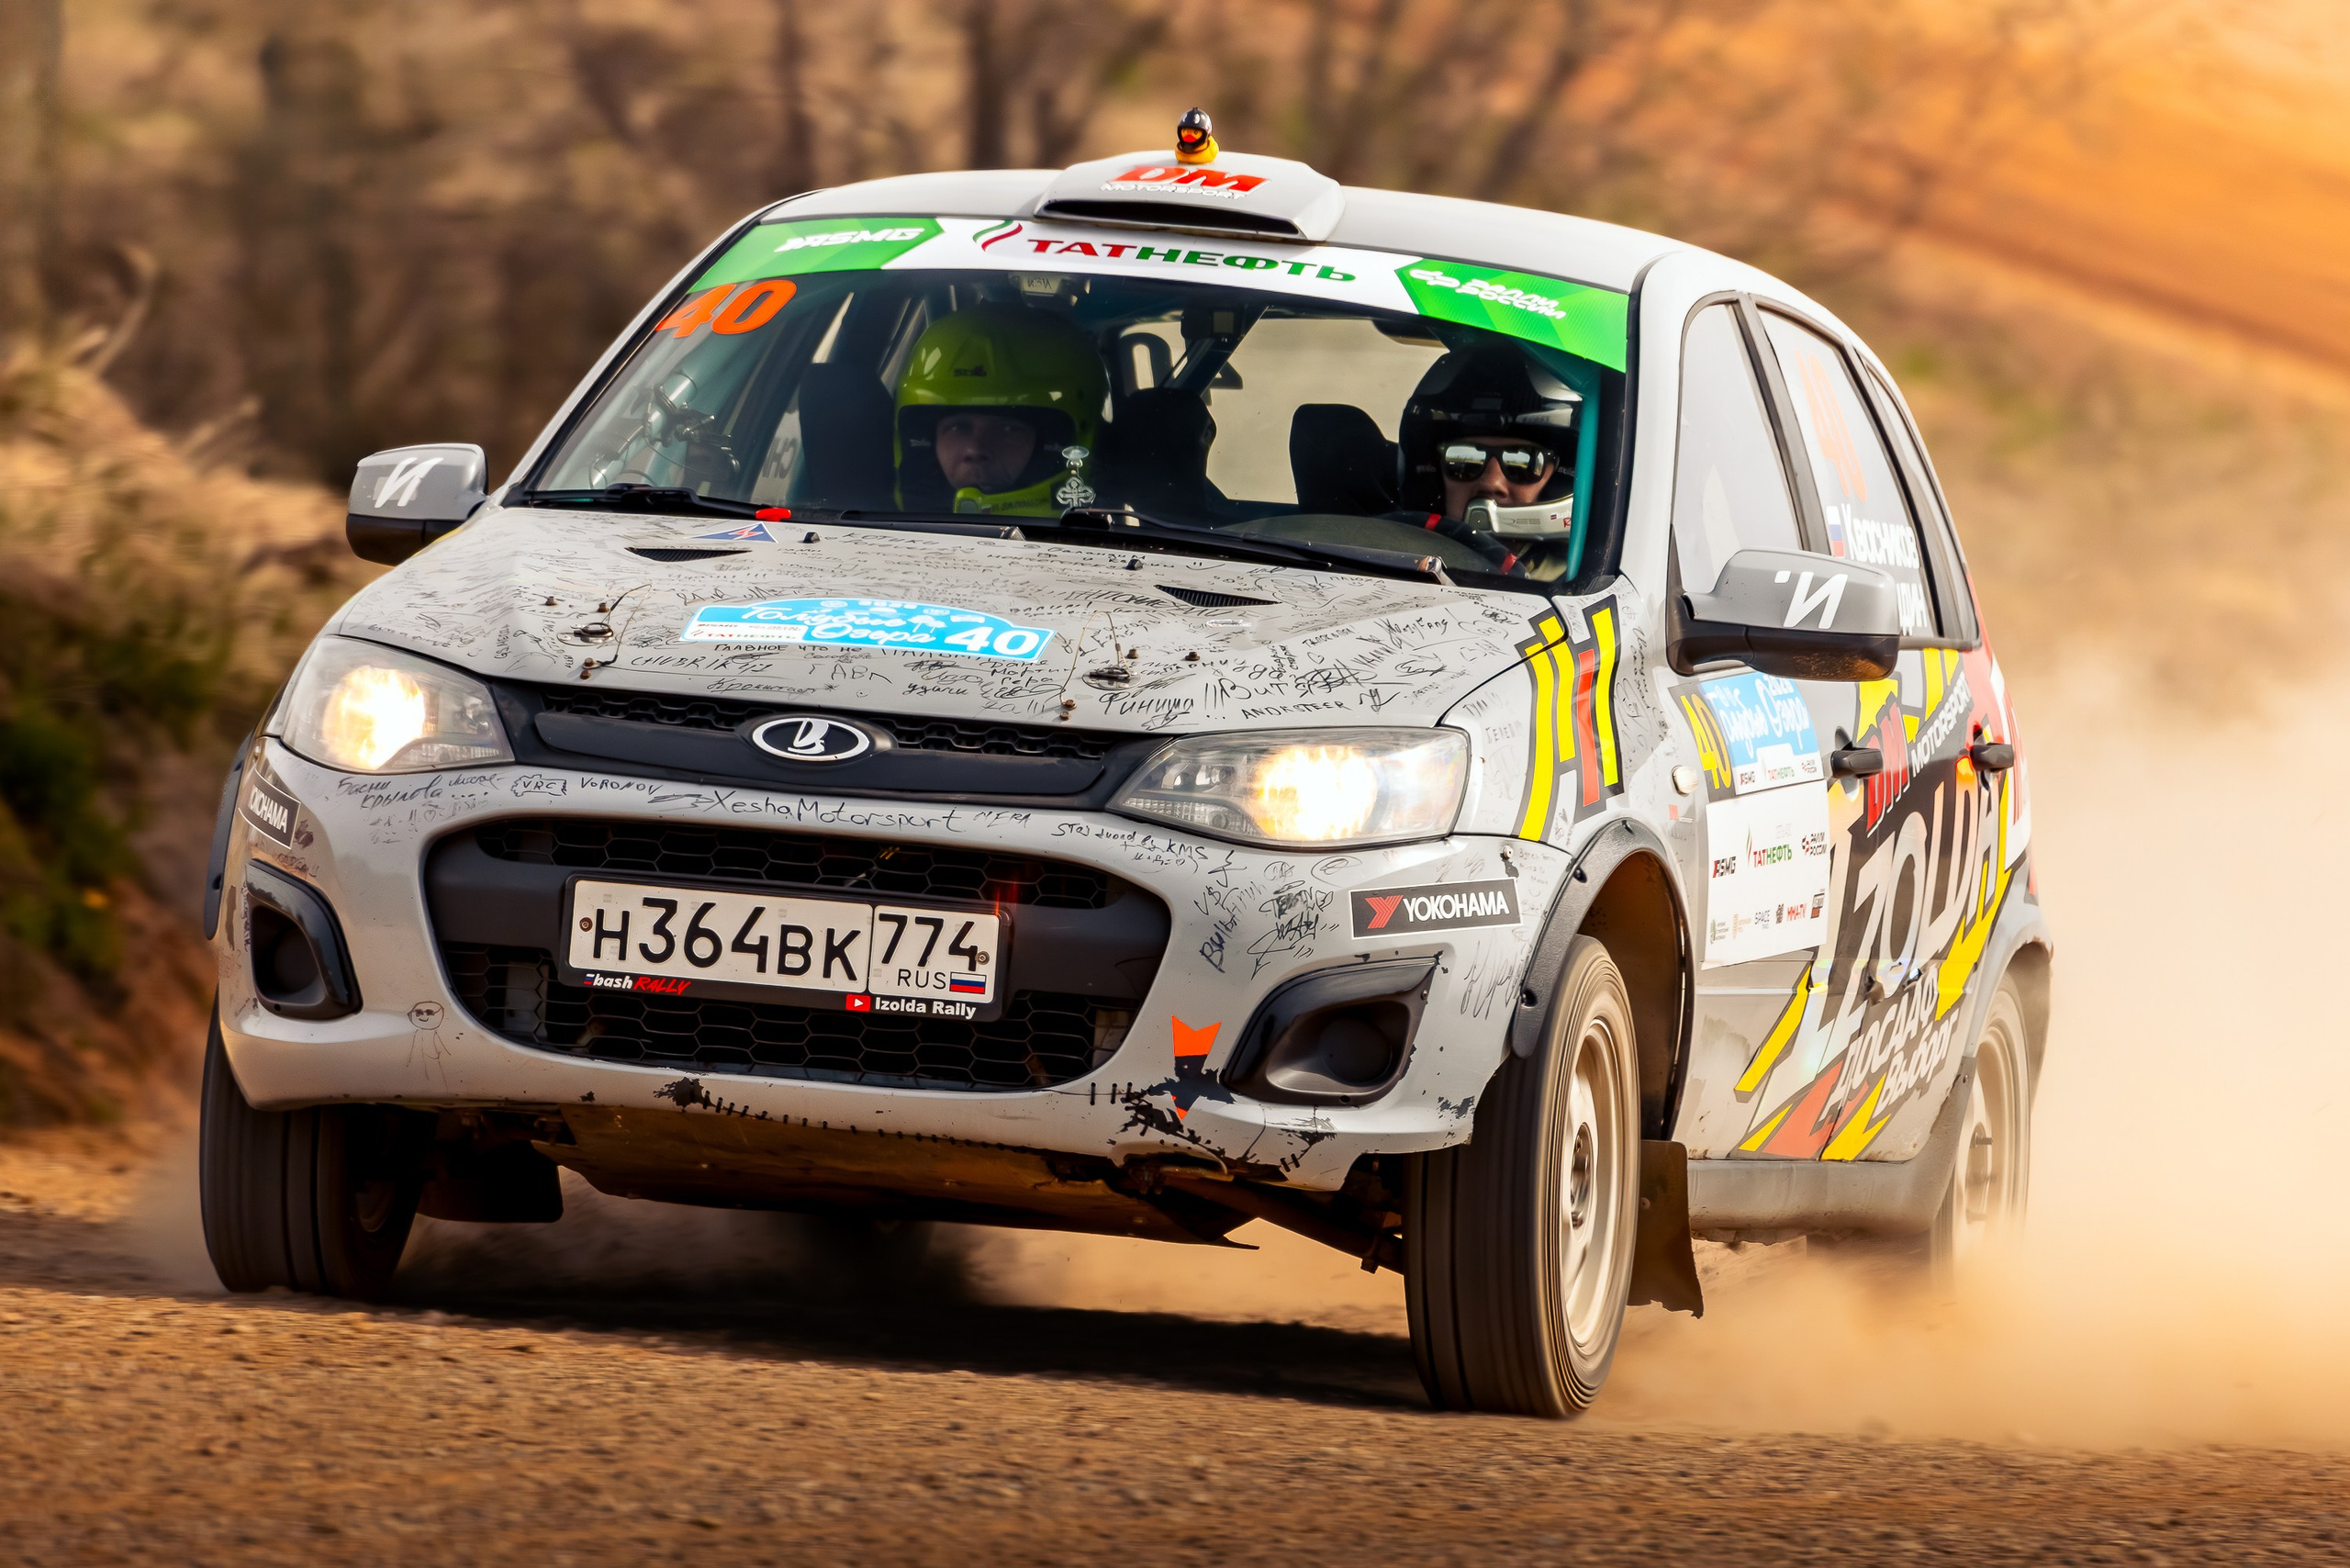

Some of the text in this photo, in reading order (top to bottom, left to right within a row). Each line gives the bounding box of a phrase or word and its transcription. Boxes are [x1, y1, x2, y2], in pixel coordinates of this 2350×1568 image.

[1100, 184, 1250, 200] MOTORSPORT
[1111, 166, 1270, 194] DM
[1027, 239, 1357, 283] ТАТНЕФТЬ
[655, 279, 798, 339] 40
[944, 626, 1040, 655] 40
[1681, 693, 1732, 790] 40
[1909, 671, 1972, 778] MOTORSPORT
[248, 784, 289, 834] OKOHAMA
[1752, 844, 1793, 868] ТАТНЕФТЬ
[1403, 890, 1510, 923] YOKOHAMA
[878, 913, 979, 972] 774
[897, 968, 947, 991] RUS
[875, 998, 977, 1019] Izolda Rally
[1818, 966, 1939, 1122] ДОСААФ
[1871, 1008, 1960, 1119] Выборг
